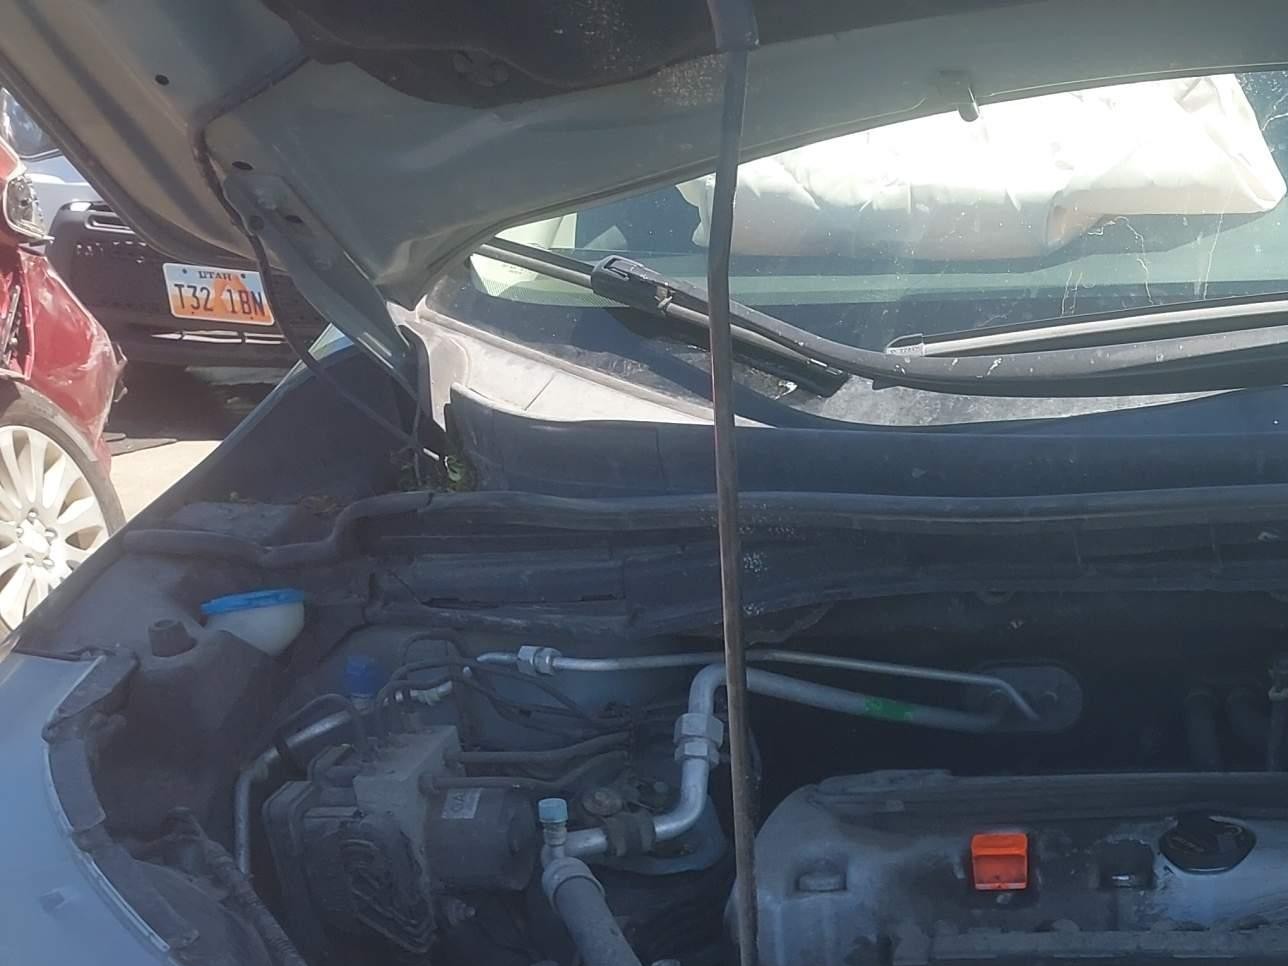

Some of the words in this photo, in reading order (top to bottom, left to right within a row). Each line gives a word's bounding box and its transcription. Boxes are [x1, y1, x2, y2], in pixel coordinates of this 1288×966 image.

[198, 270, 232, 281] UTAH
[174, 283, 214, 312] T32
[226, 288, 266, 317] 1BN
